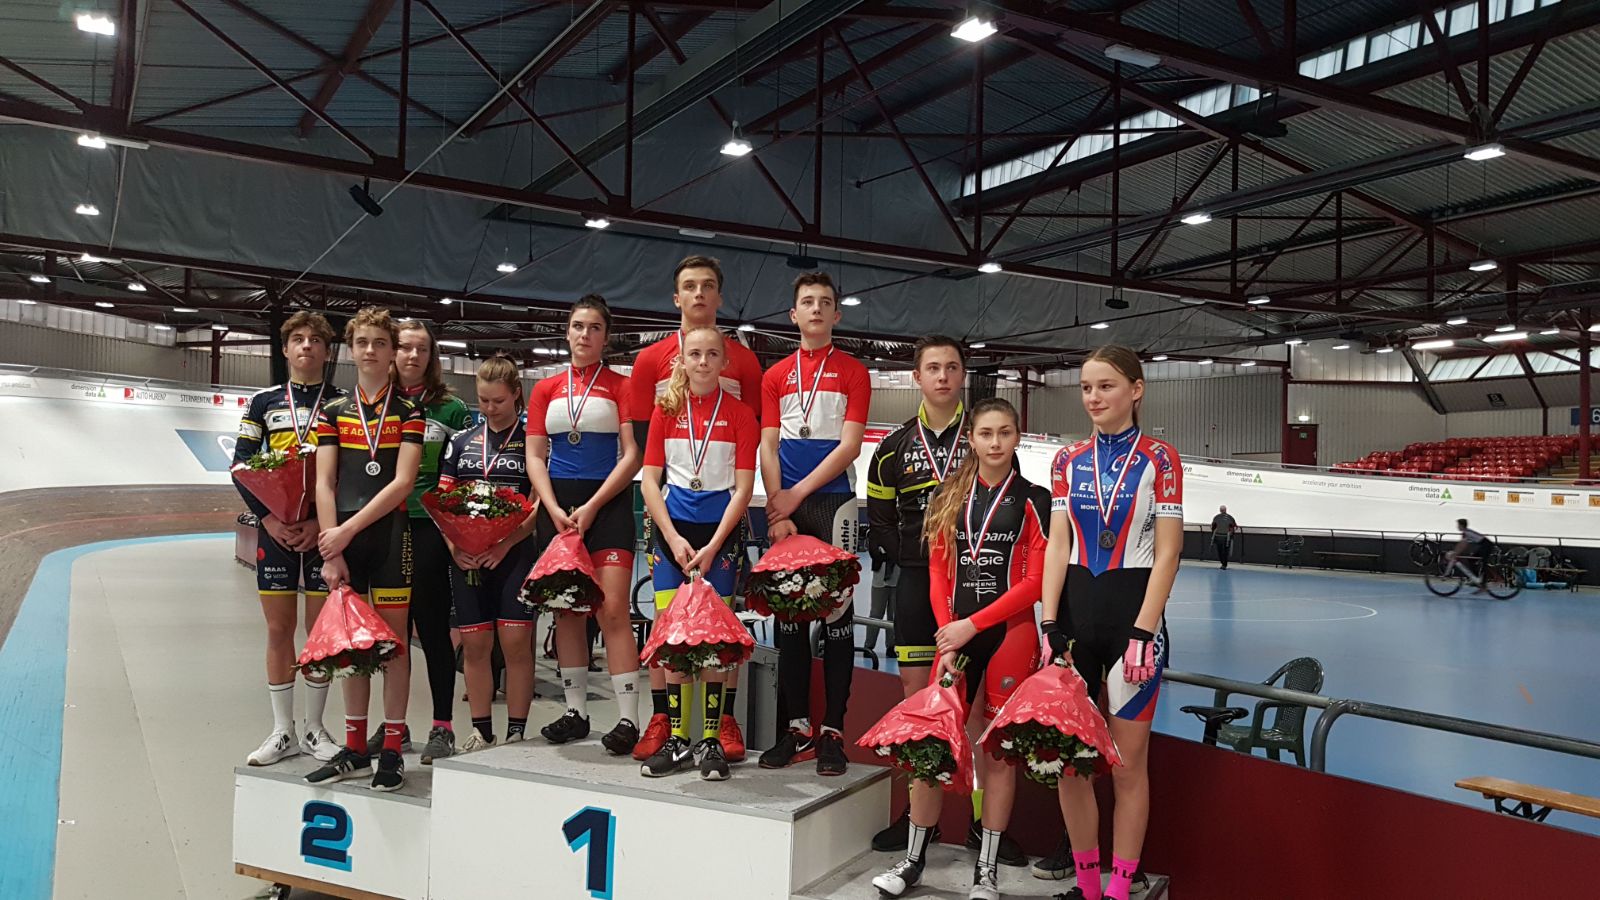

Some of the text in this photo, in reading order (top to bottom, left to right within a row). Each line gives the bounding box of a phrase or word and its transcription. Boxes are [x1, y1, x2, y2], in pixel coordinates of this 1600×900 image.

[340, 426, 349, 434] DE
[1408, 485, 1440, 493] dimension
[300, 800, 353, 872] 2
[562, 806, 616, 900] 1
